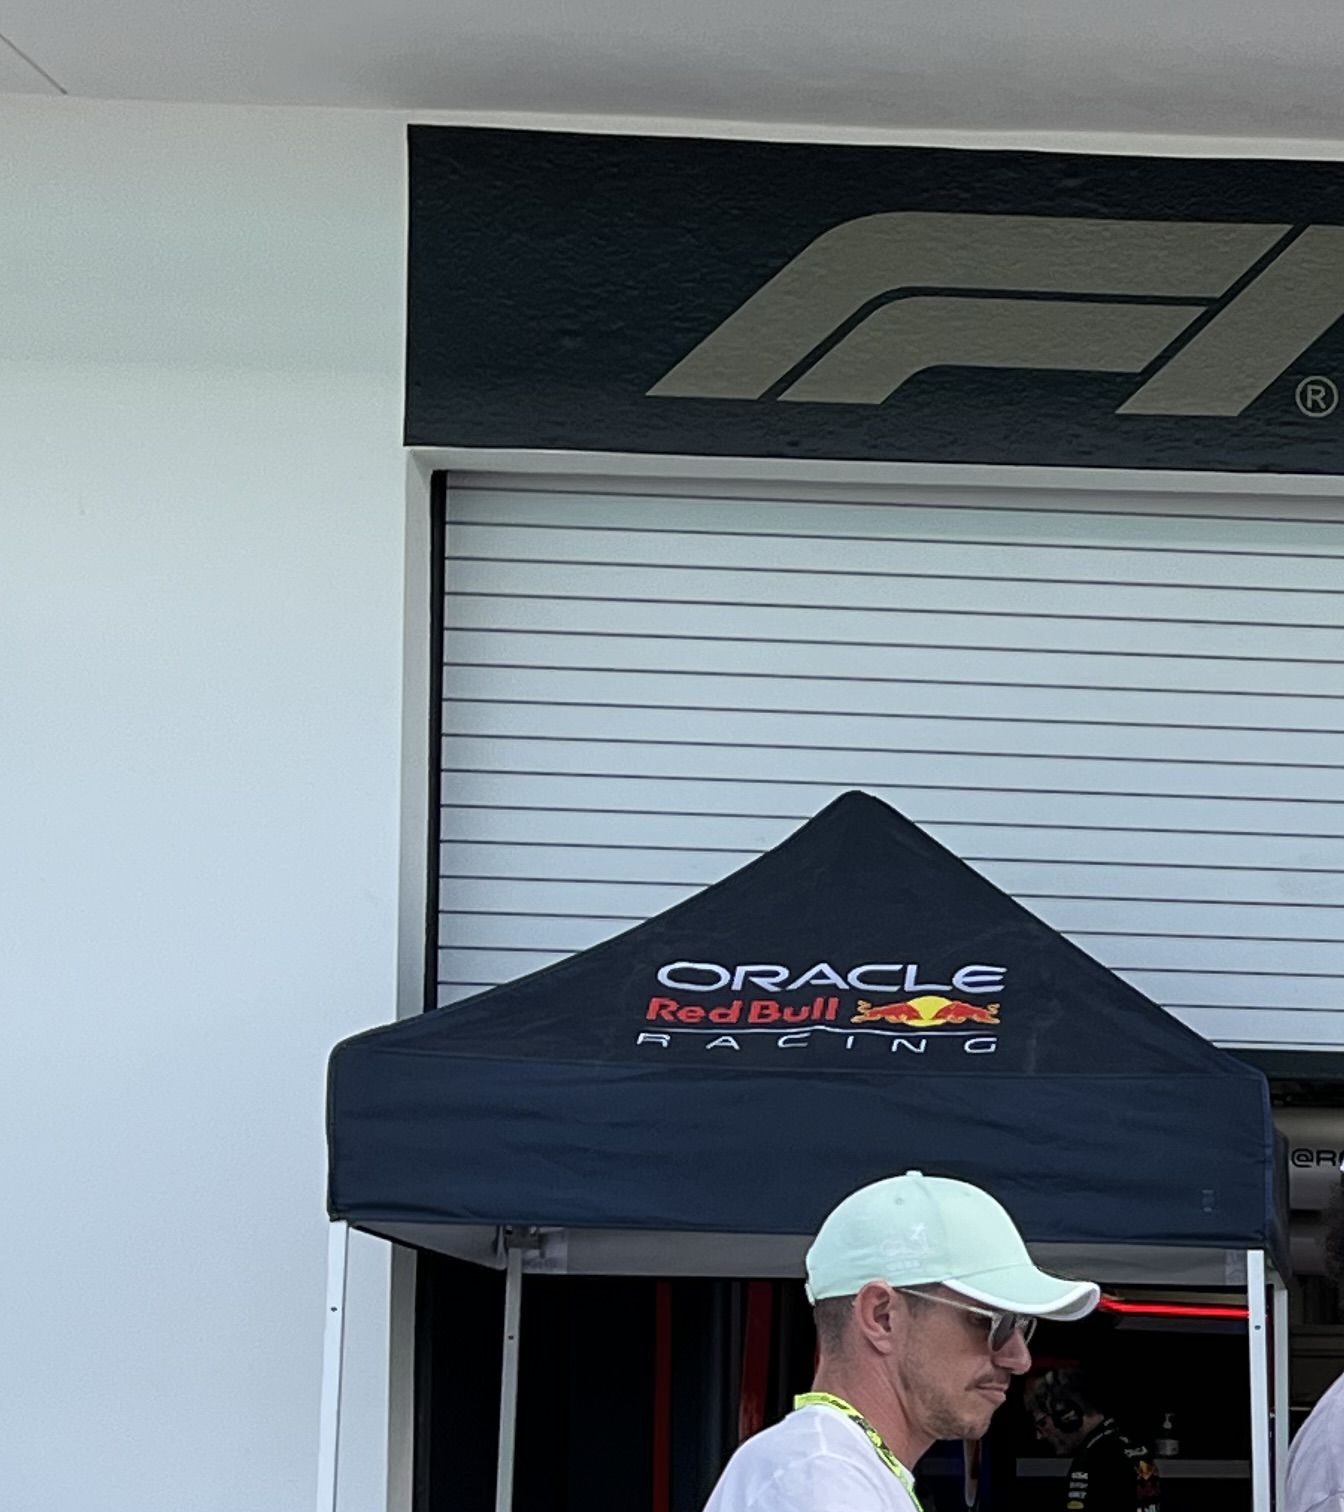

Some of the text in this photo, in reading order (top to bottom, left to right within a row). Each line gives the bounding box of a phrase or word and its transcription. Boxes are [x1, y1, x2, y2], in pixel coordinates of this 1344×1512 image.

[656, 961, 1008, 993] ORACLE
[645, 996, 839, 1024] Red Bull
[636, 1032, 998, 1054] RACING
